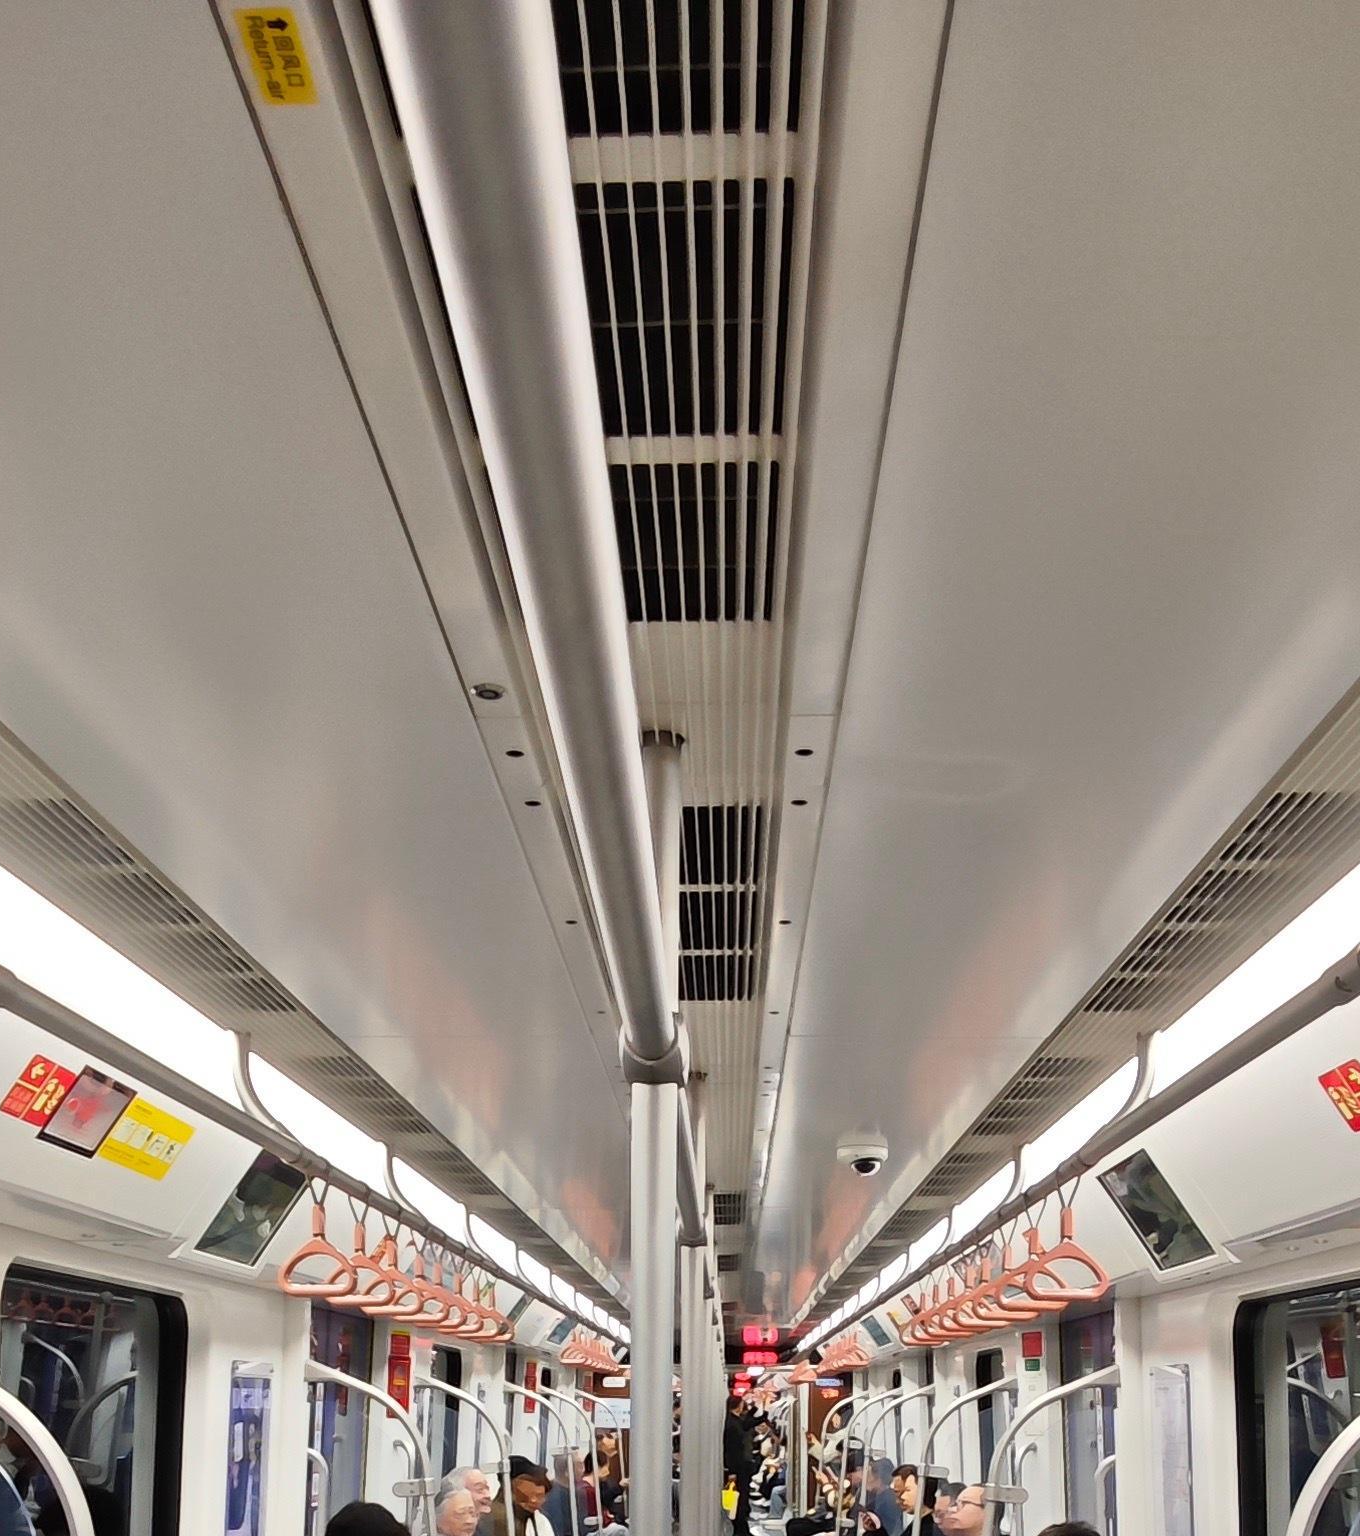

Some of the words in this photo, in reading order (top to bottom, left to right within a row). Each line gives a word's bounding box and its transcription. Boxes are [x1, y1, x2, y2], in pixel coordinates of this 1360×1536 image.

[245, 15, 285, 100] Return-air
[272, 35, 305, 88] 回风口
